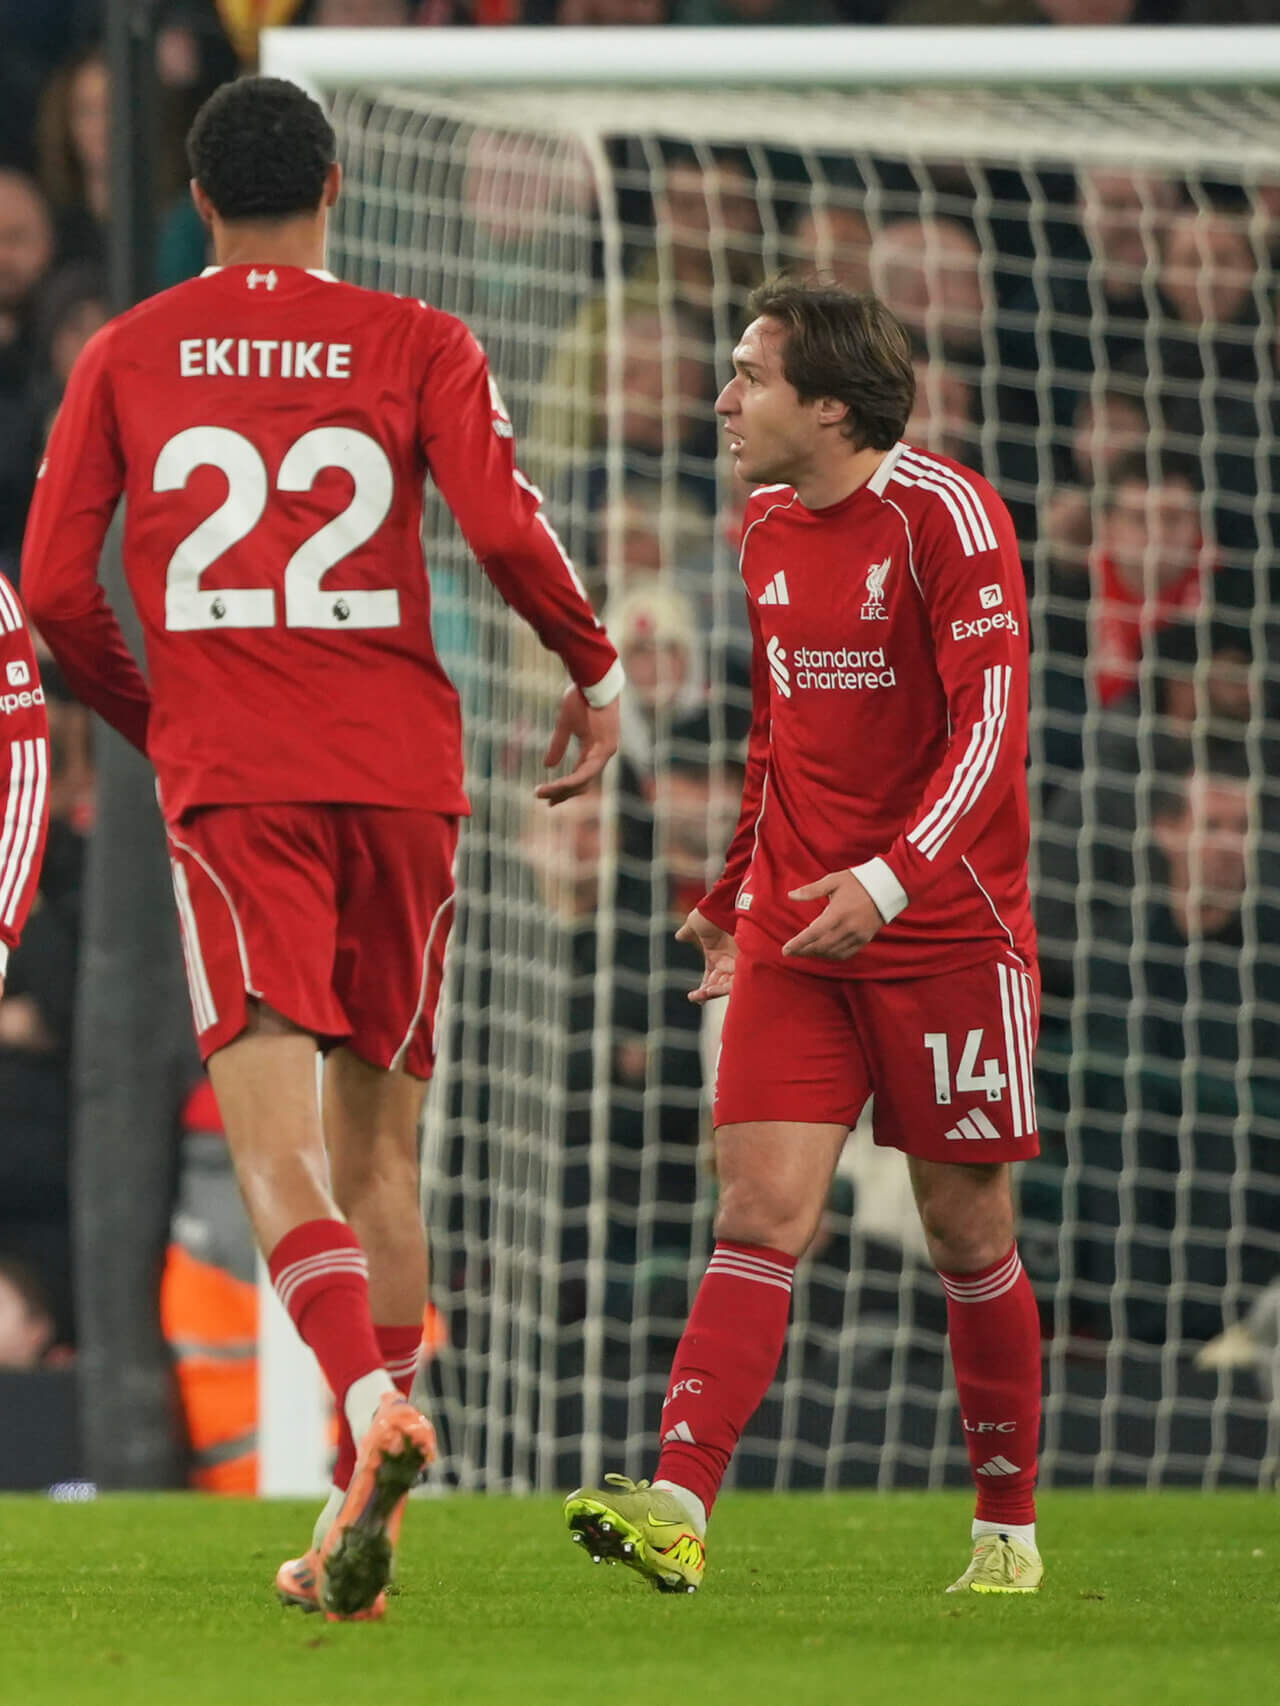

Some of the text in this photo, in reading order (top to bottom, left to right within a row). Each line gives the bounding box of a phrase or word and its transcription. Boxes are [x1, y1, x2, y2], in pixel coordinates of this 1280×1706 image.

[179, 338, 352, 379] EKITIKE
[153, 426, 400, 631] 22
[794, 646, 885, 668] standard
[796, 666, 897, 689] chartered
[924, 1028, 1007, 1104] 14
[963, 1419, 1016, 1432] LFC
